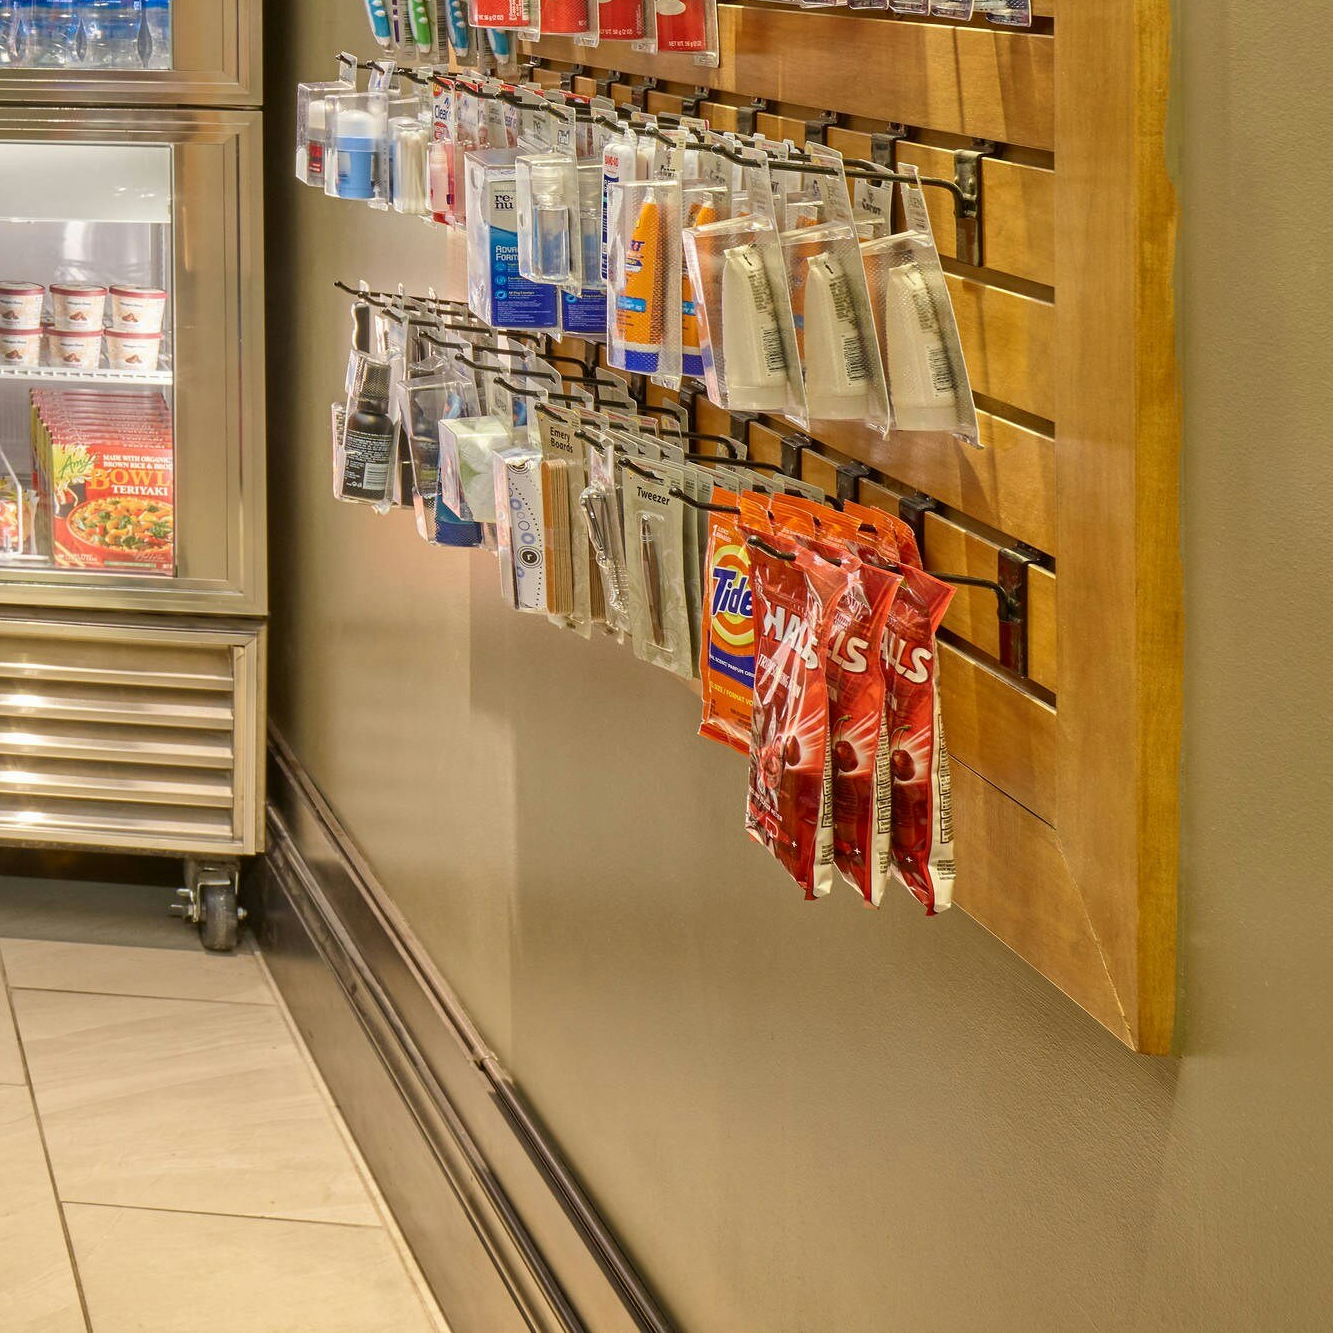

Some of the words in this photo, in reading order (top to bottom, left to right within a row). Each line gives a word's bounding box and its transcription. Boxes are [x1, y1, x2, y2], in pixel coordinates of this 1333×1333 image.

[495, 201, 514, 210] nu
[496, 245, 518, 253] ADVA
[496, 252, 519, 261] FORM
[549, 426, 571, 442] Emery
[549, 438, 574, 454] Boards
[88, 468, 171, 490] BOWL
[111, 484, 168, 496] TERIYAKI
[636, 486, 670, 506] Tweezer
[712, 566, 753, 619] Tide
[726, 688, 745, 703] FORMAT
